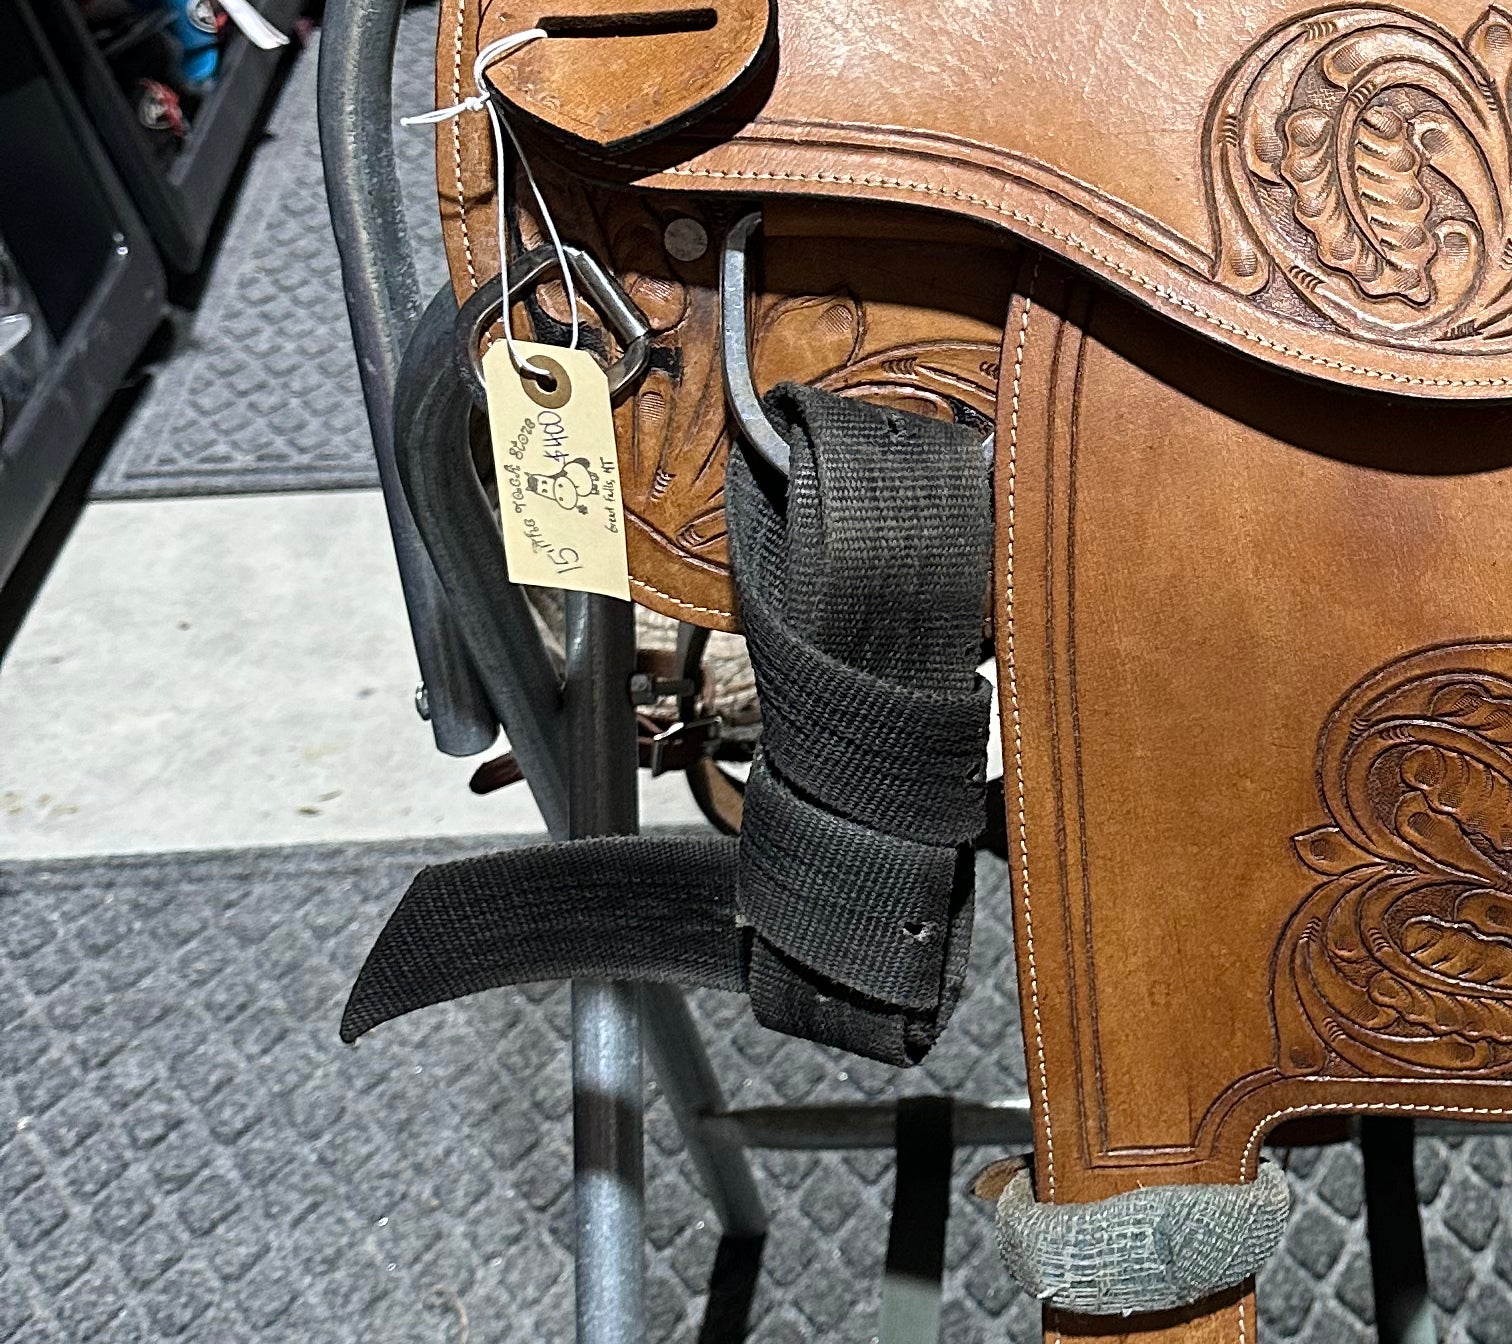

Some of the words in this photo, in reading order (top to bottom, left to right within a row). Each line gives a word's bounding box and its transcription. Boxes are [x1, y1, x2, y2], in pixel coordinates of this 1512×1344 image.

[537, 411, 569, 464] $400
[599, 456, 616, 474] MT
[602, 479, 616, 503] Falls,
[604, 507, 619, 534] Great
